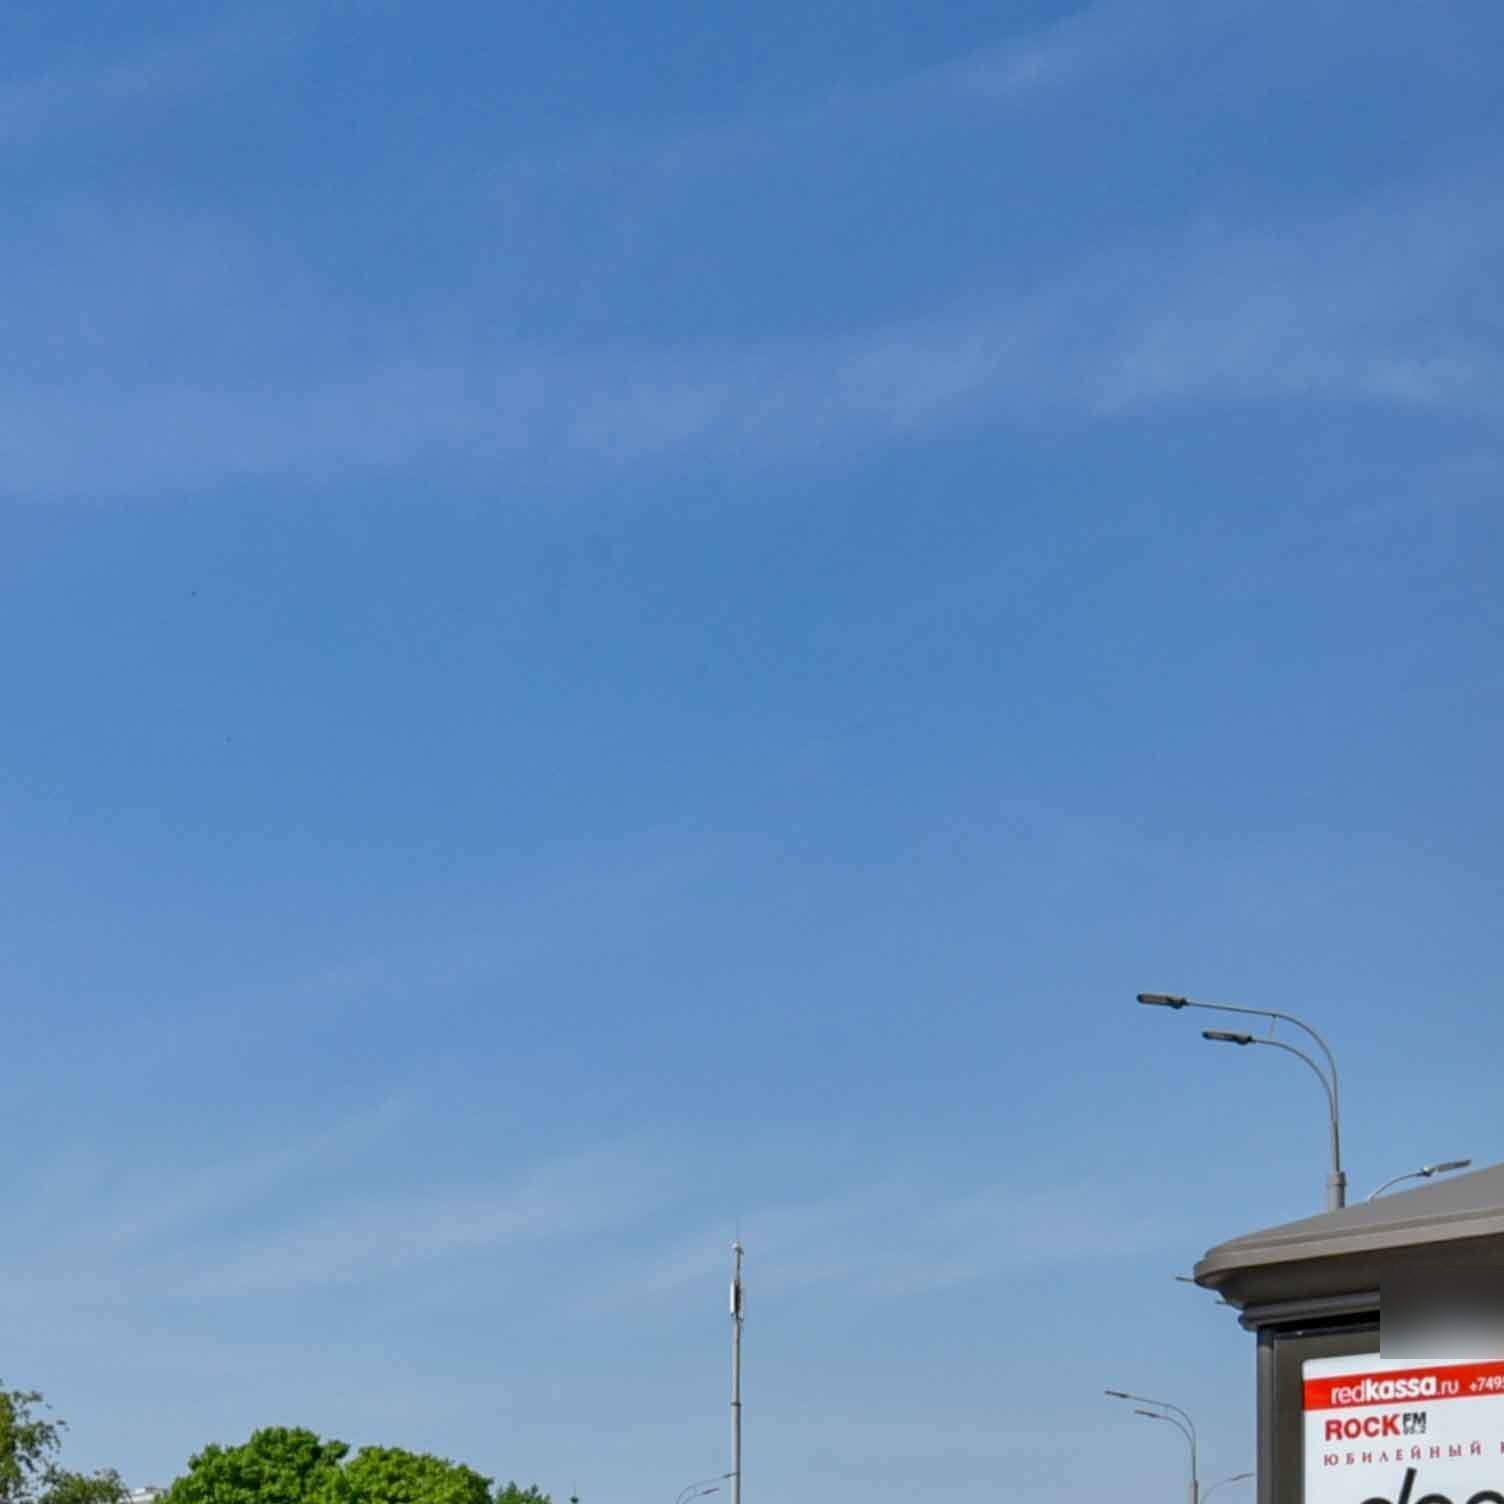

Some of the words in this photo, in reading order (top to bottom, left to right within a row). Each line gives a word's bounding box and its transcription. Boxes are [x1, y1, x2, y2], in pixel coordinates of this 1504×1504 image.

[1330, 1376, 1460, 1405] redkassa.ru
[1325, 1413, 1401, 1441] ROCK
[1402, 1411, 1427, 1425] FM
[1324, 1440, 1481, 1466] ЮБИЛЕЙНЫЙ
